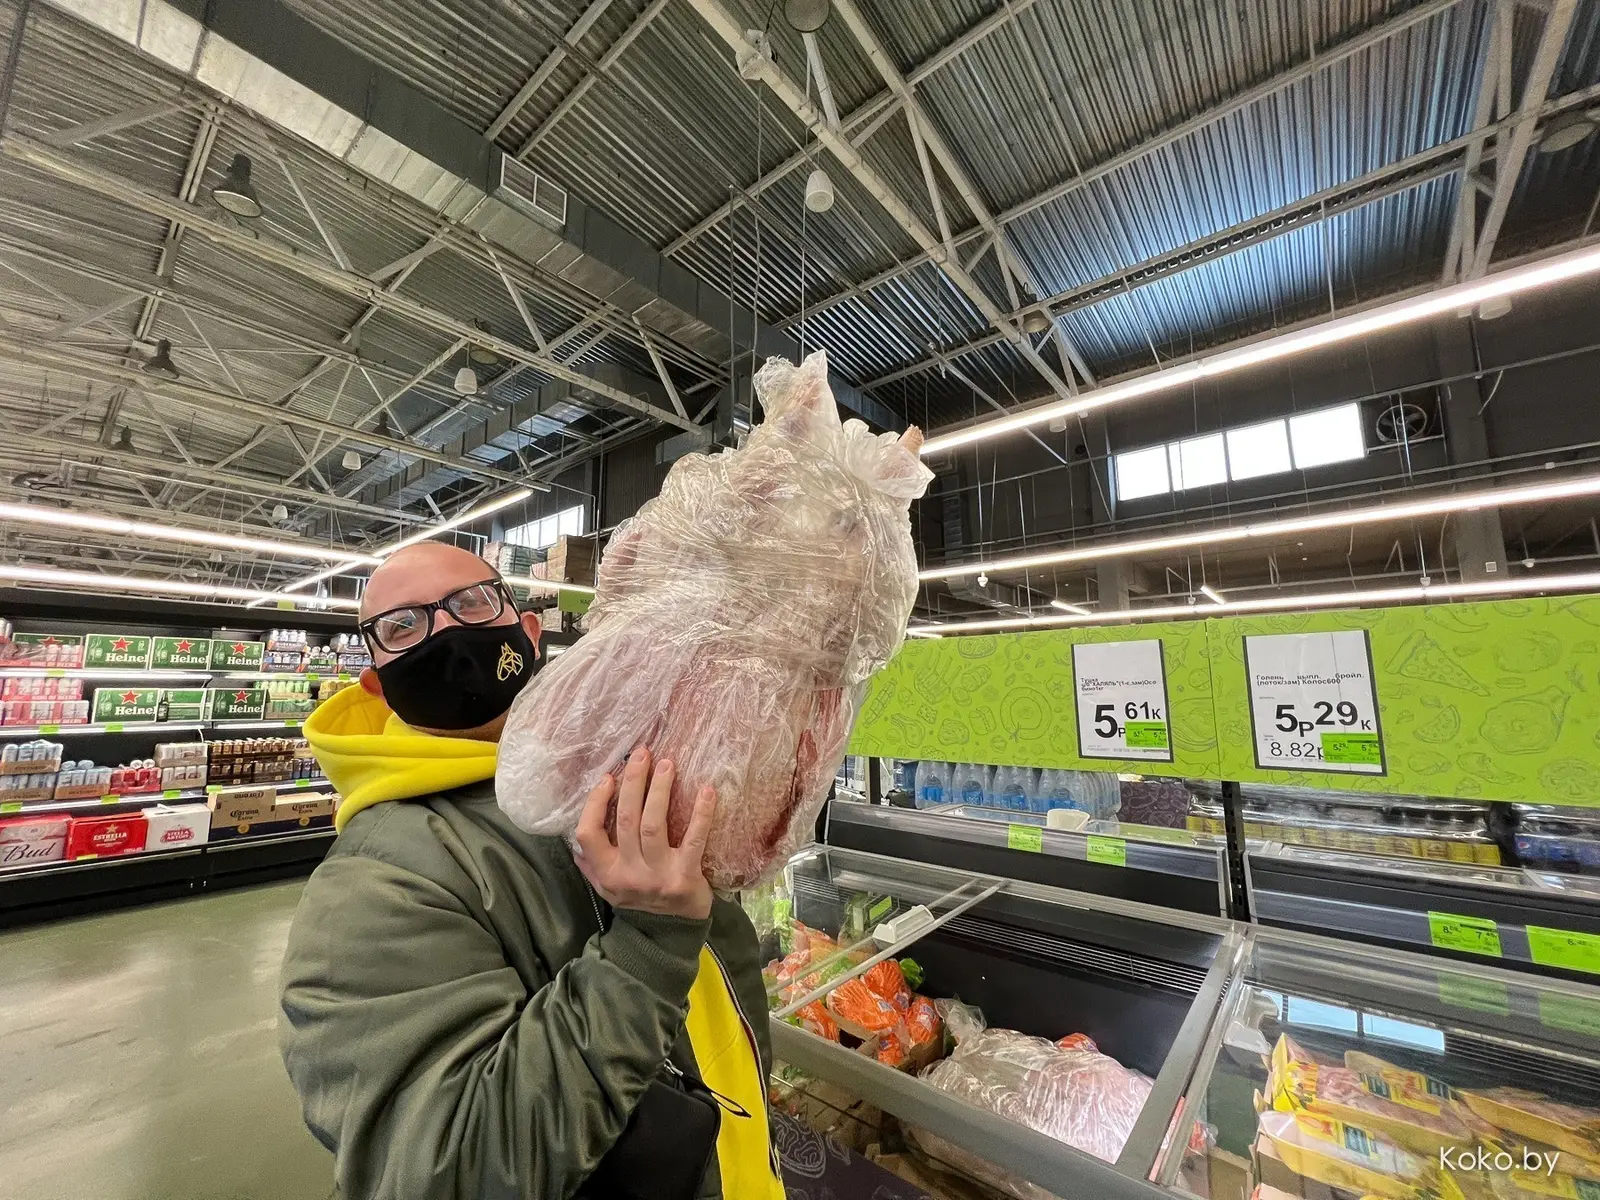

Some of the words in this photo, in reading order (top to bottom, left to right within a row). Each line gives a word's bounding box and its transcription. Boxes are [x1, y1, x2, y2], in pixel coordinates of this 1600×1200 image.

[291, 802, 318, 811] Corona
[230, 808, 260, 818] Corona
[93, 832, 127, 841] ESTRELLA
[2, 842, 57, 862] Bud
